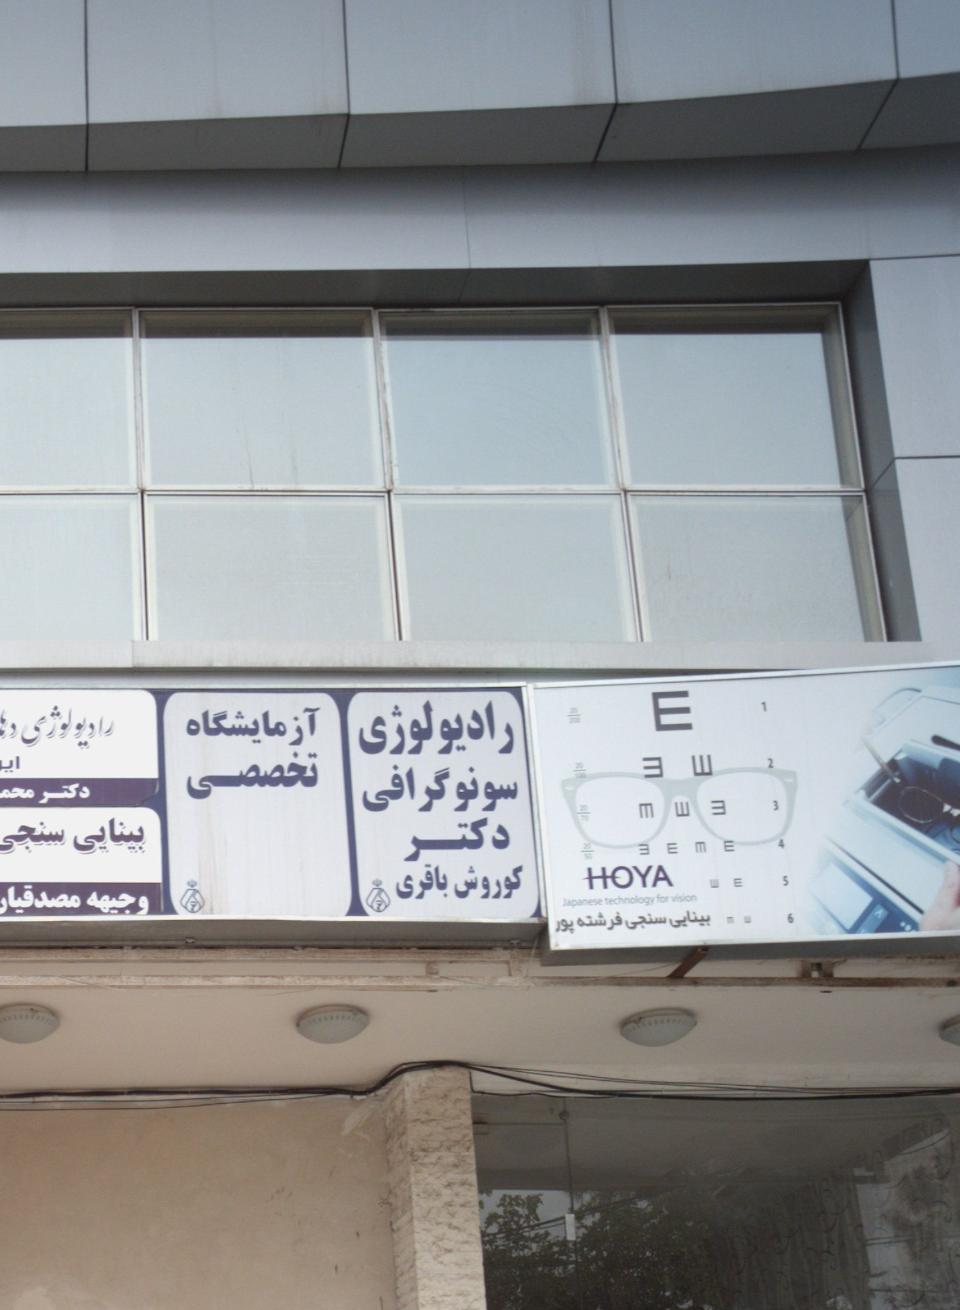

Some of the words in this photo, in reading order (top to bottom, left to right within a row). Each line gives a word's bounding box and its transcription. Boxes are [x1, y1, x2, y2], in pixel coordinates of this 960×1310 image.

[21, 705, 114, 750] رادیولوژی
[186, 707, 321, 746] آزمایشگاه
[358, 700, 515, 755] رادیولوژی
[33, 783, 90, 804] دکتر
[187, 752, 319, 800] تخصصی
[362, 765, 519, 813] سونوگرافی
[72, 817, 146, 854] بینایی
[403, 817, 511, 862] دکتر
[395, 864, 448, 900] باقری
[454, 864, 524, 900] کوروش
[583, 864, 674, 890] HOYA
[87, 886, 150, 916] وجیهه
[562, 897, 603, 909] Japanese
[604, 895, 656, 908] technology
[656, 894, 670, 904] for
[670, 893, 698, 904] vision
[669, 910, 711, 928] بینایی
[555, 918, 575, 934] پور
[577, 912, 623, 931] فرشته
[625, 914, 667, 930] سنجی
